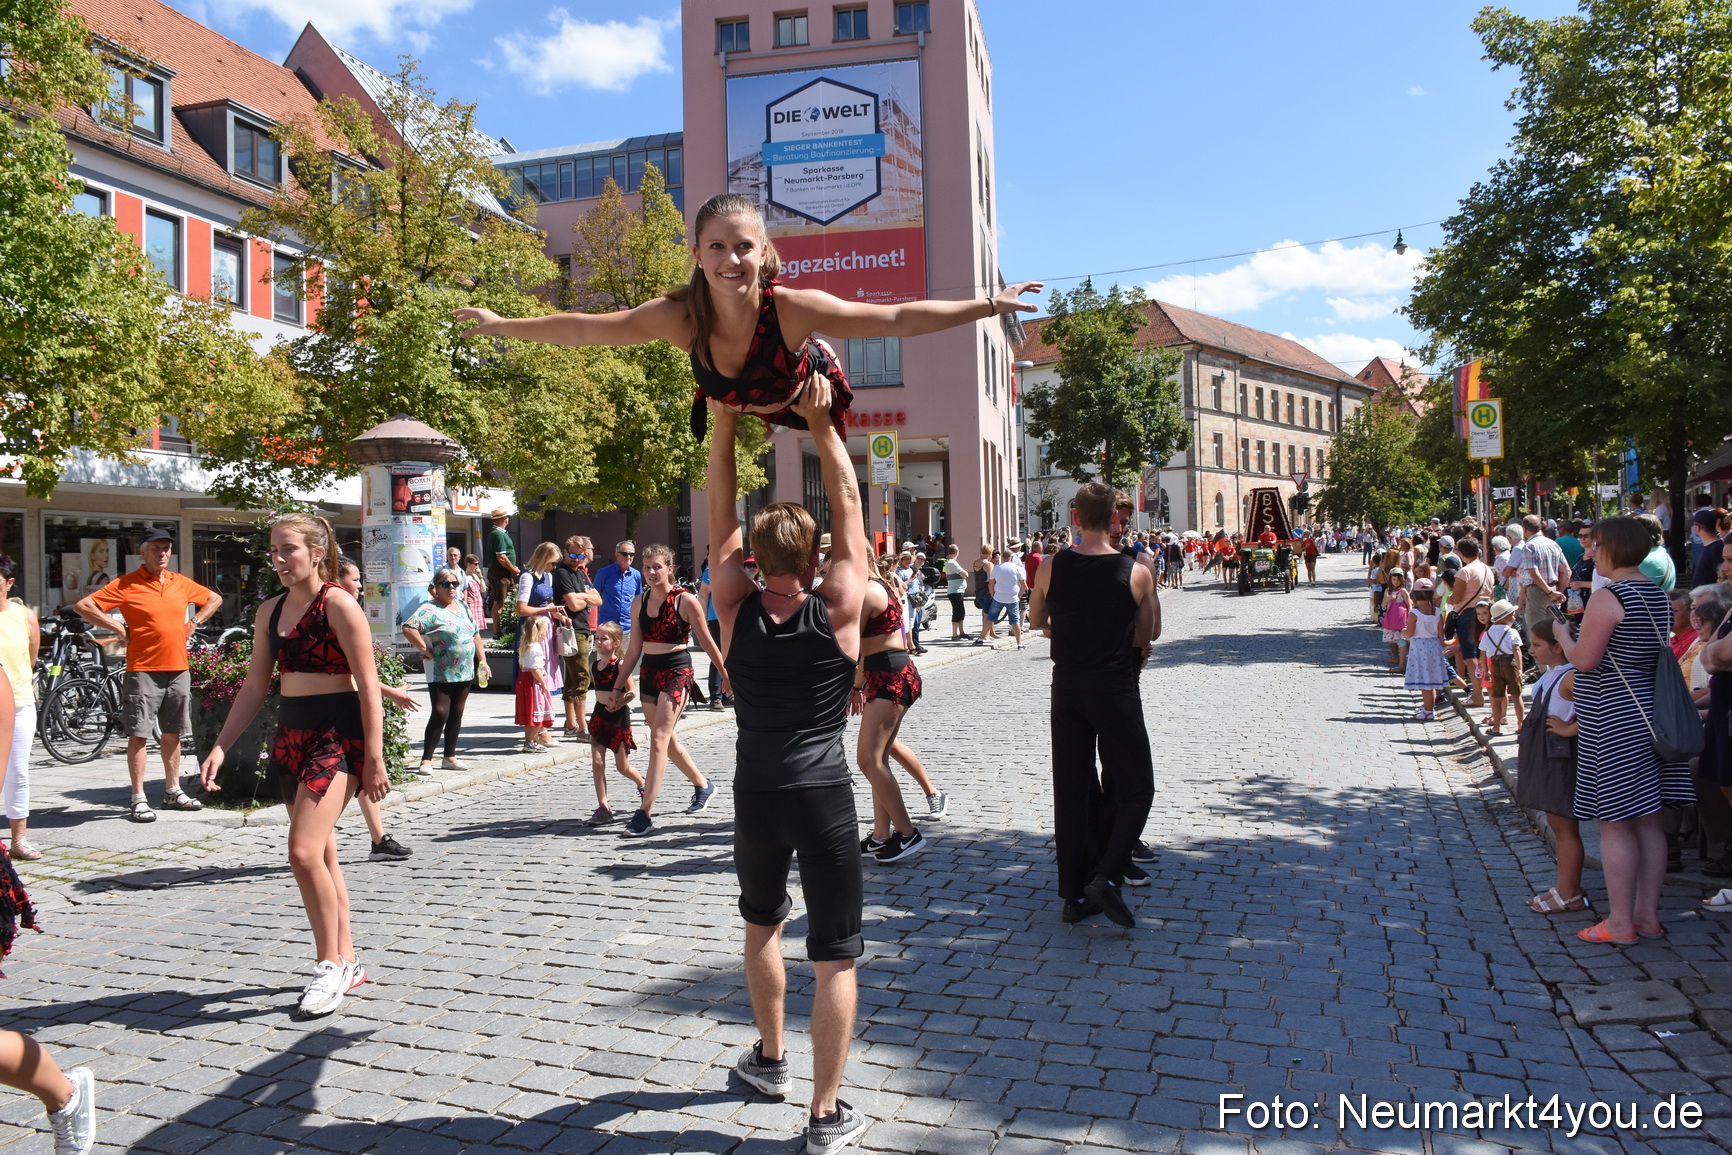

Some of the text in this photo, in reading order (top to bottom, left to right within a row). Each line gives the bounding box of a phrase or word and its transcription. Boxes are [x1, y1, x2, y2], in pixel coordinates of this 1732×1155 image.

[774, 110, 802, 124] DIE
[801, 129, 830, 138] September
[784, 139, 862, 152] SIEGER BANKENTEST
[773, 147, 874, 162] Beratung Baufinanzierung
[803, 165, 844, 174] Sparkasse
[784, 172, 864, 184] Neumarkt-Parsberg
[779, 248, 905, 278] sgezeichnet!
[847, 409, 906, 428] kasse
[1478, 409, 1490, 422] H
[877, 441, 888, 454] H
[1500, 488, 1512, 498] WC
